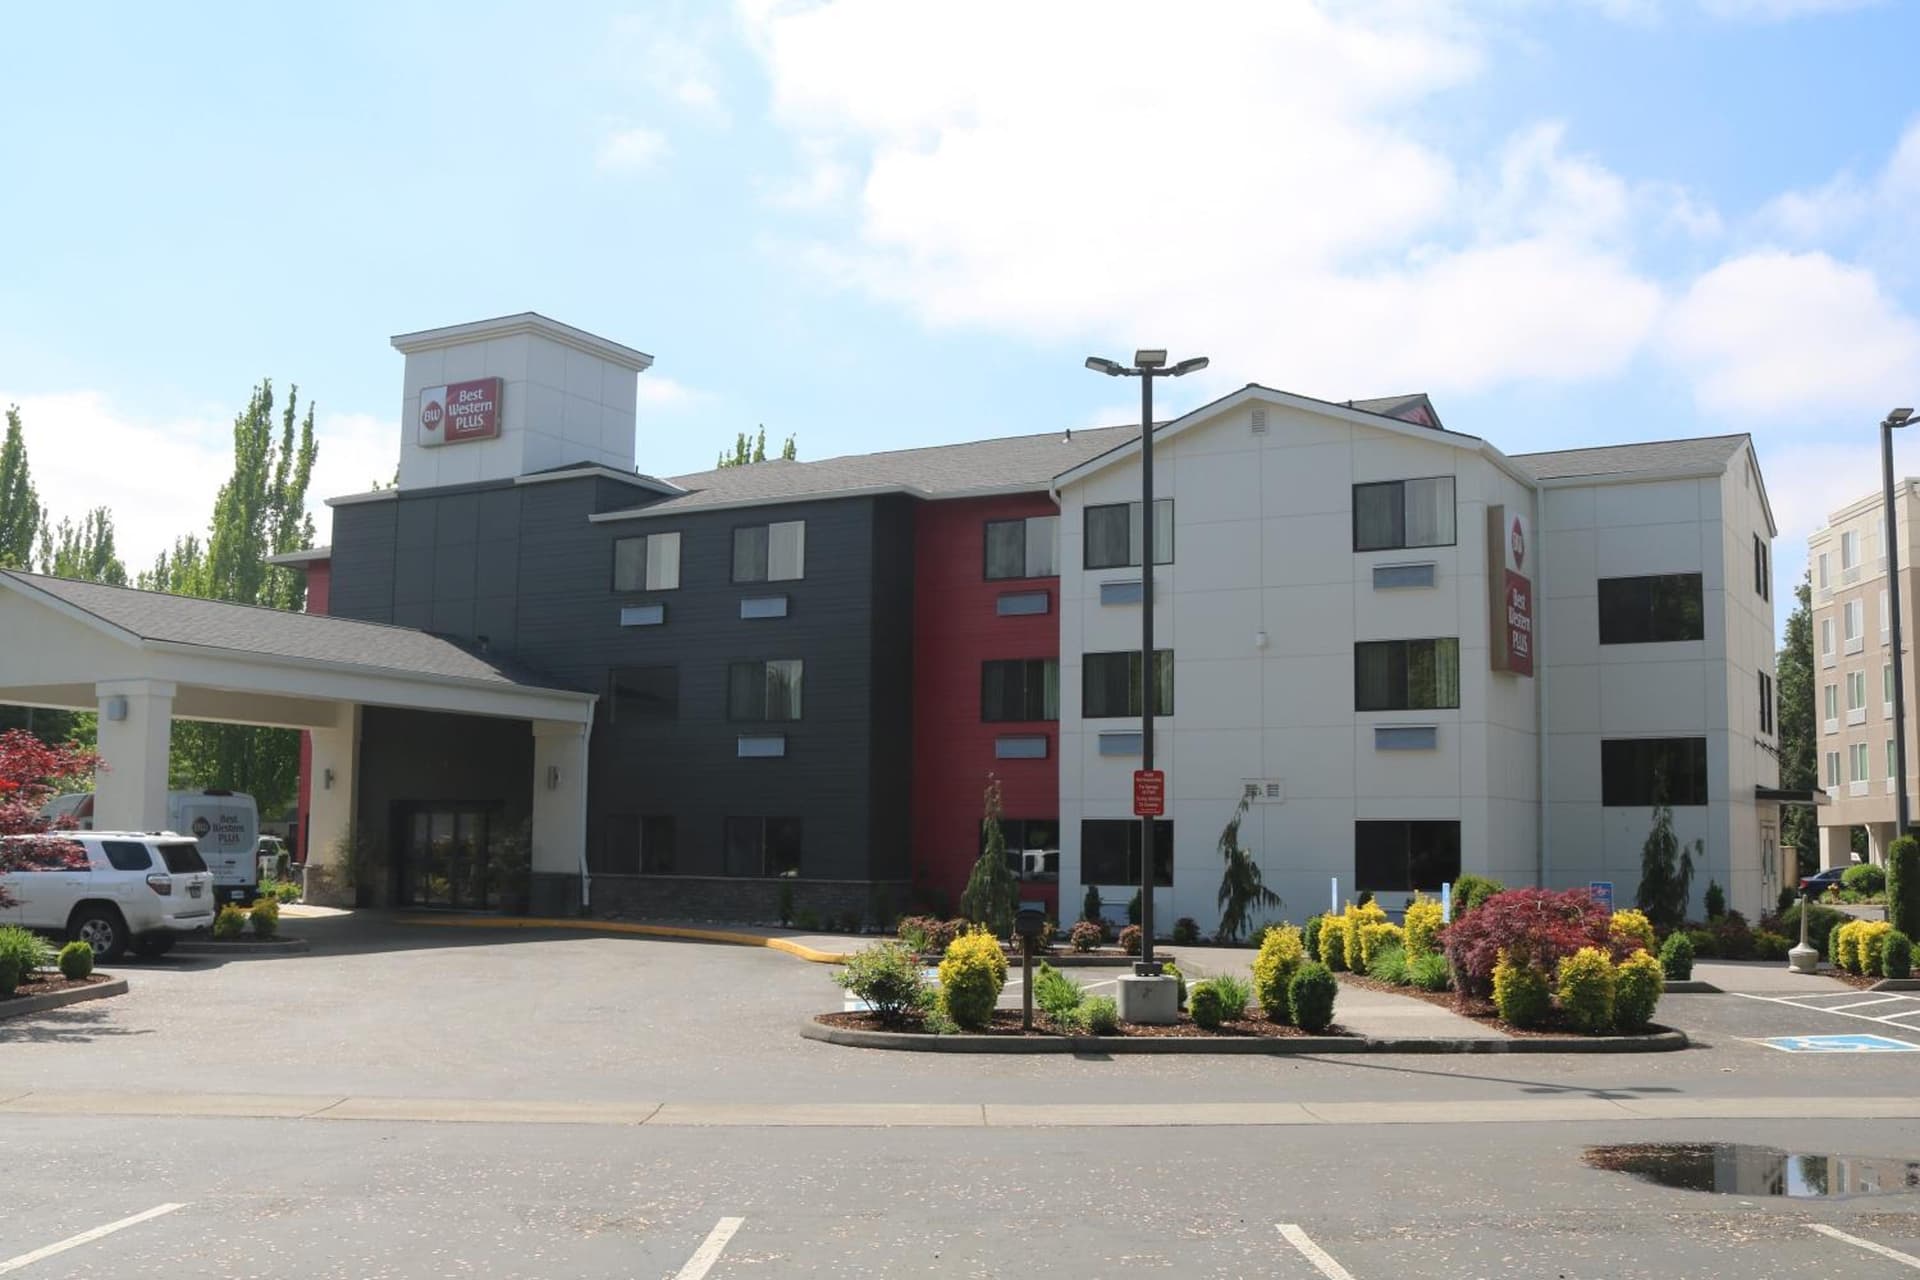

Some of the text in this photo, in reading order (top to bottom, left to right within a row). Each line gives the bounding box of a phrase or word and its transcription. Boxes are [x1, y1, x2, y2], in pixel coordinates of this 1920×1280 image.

[459, 389, 484, 402] Best
[448, 401, 493, 416] Western
[456, 414, 484, 430] PLUS
[1512, 630, 1528, 652] PLUS
